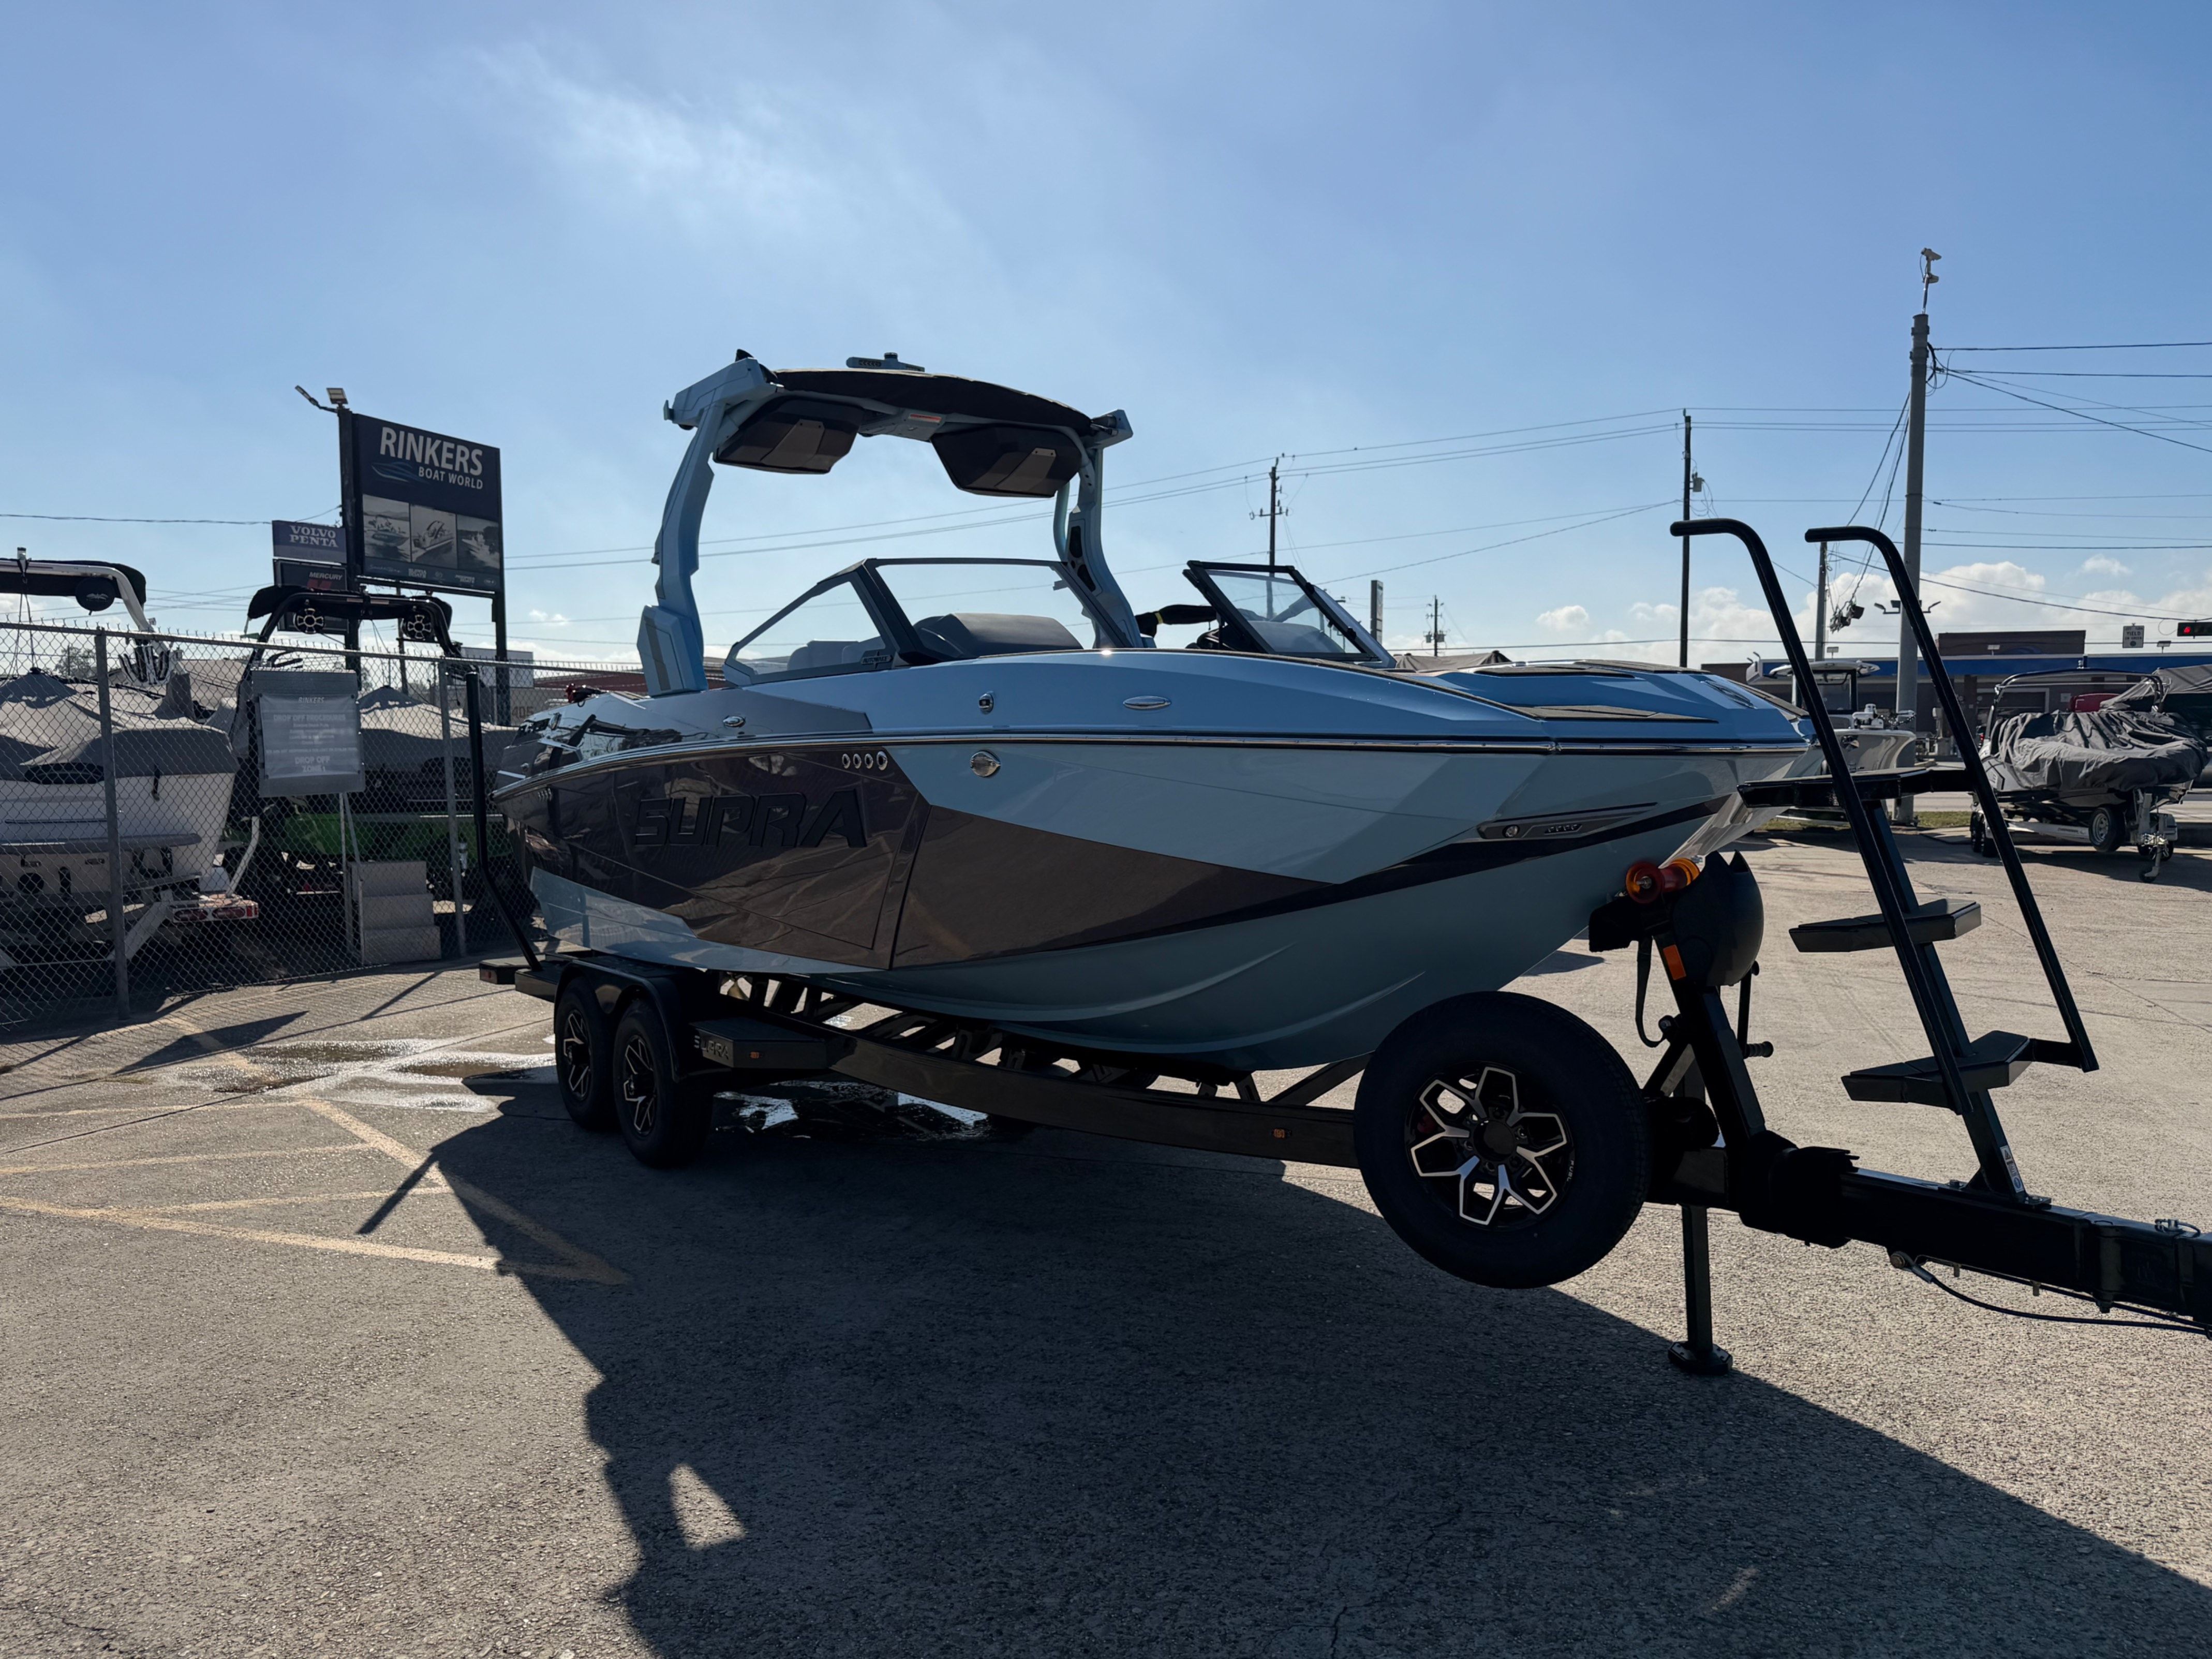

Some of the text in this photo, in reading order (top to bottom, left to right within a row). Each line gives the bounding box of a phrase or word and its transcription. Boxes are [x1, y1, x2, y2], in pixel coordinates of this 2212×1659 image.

[379, 427, 483, 476] RINKERS
[418, 466, 483, 490] BOAT WORLD
[290, 525, 336, 539] VOLVO
[290, 534, 338, 547] PENTA
[309, 572, 343, 581] MERCURY
[635, 788, 868, 848] SUPRA
